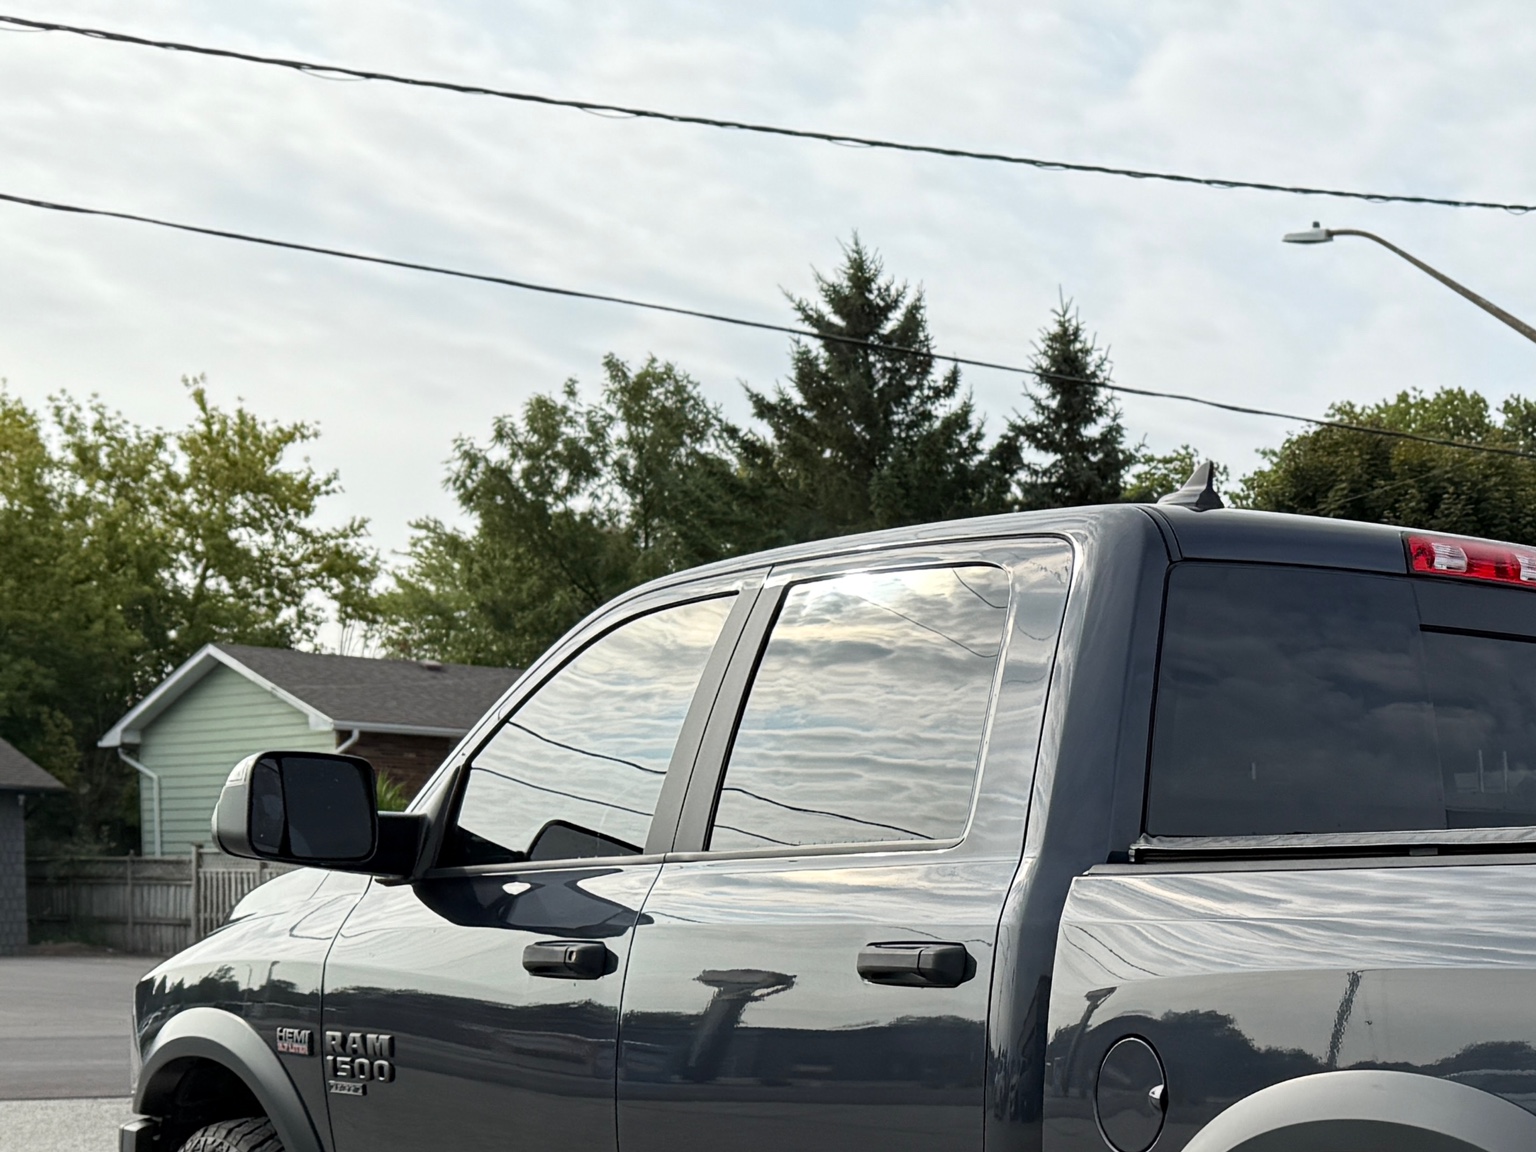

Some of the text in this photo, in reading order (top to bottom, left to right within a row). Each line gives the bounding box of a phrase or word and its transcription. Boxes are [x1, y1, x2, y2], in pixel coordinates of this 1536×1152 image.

[276, 1027, 312, 1045] HEMI
[325, 1031, 392, 1057] RAM
[325, 1055, 395, 1082] 1500
